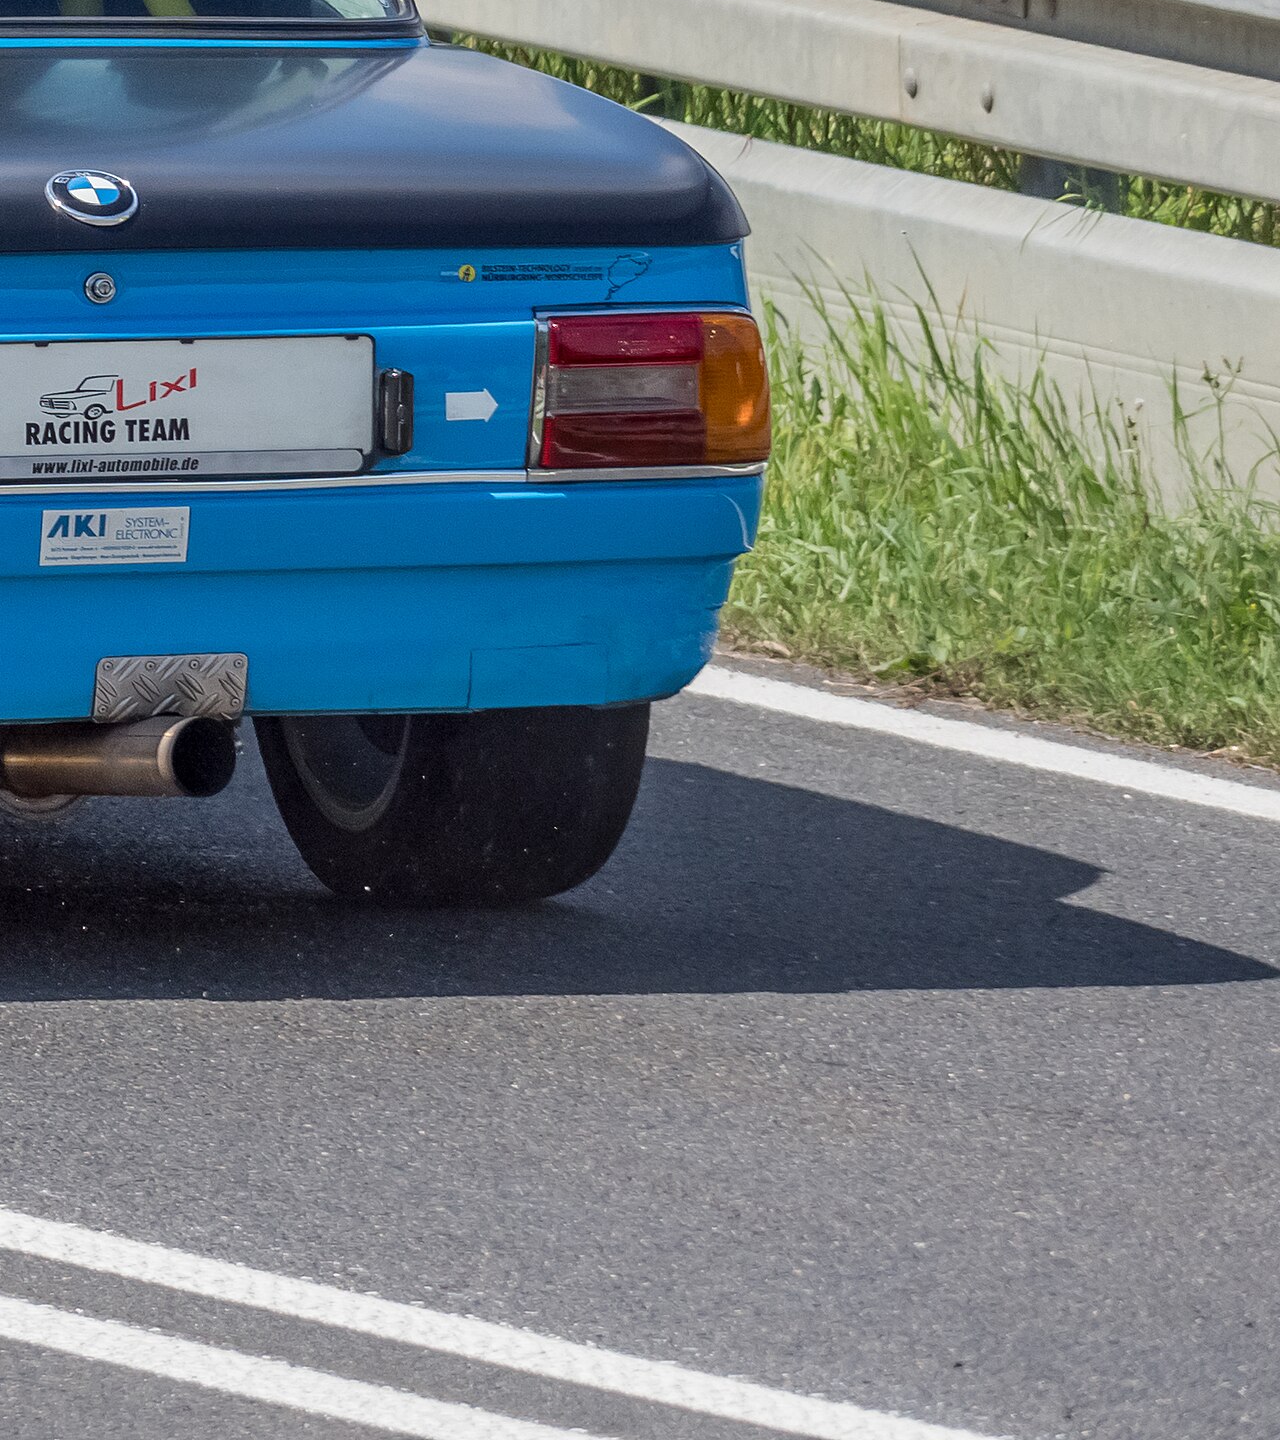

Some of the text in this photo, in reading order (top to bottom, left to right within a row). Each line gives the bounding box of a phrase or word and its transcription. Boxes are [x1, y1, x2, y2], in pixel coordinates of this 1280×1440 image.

[25, 418, 190, 446] RACING TEAM
[46, 514, 107, 539] AKI
[115, 528, 178, 541] ELECTRONIC
